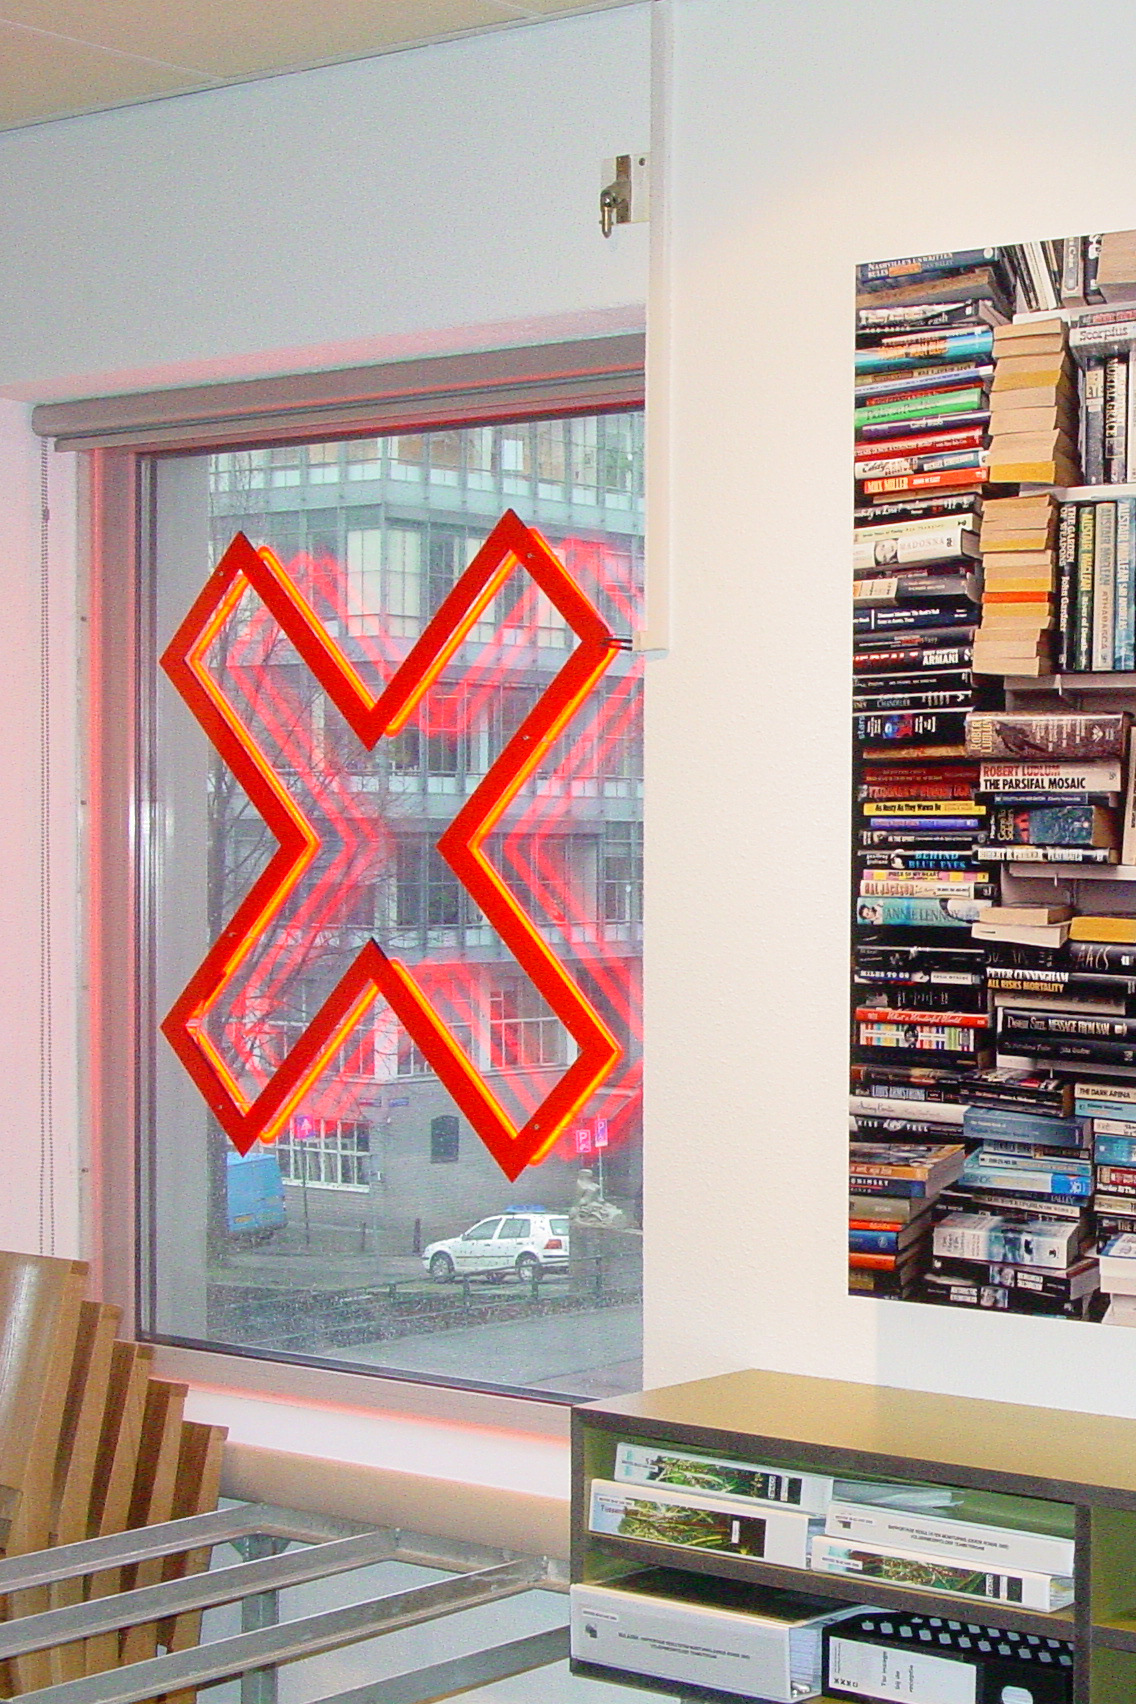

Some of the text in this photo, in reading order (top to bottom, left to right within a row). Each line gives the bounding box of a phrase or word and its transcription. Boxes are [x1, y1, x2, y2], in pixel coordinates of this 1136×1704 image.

[867, 252, 953, 271] NASHVILLE'S UNWRITTEN
[867, 268, 889, 279] RULES
[1079, 326, 1129, 342] Scorpius
[1105, 357, 1118, 437] MORTAL GRACE
[1100, 507, 1112, 546] ALISTAIR
[1118, 502, 1130, 541] ALISTAIR
[1066, 505, 1077, 562] THE GARDEN
[1081, 513, 1093, 551] ALISTAIR
[899, 538, 945, 550] MADONNA
[1059, 507, 1070, 632] OF WEAPONS John Gardner
[1081, 596, 1089, 616] River
[1100, 591, 1109, 650] ATHABASCA
[1118, 597, 1127, 630] ANDREAS
[1081, 617, 1089, 626] of
[1080, 627, 1089, 652] Death
[922, 653, 959, 666] ARMANI
[983, 765, 1061, 777] ROBERT LUDLUM
[983, 779, 1000, 790] THE
[1002, 778, 1046, 790] PARSIFAL
[1048, 777, 1086, 790] MOSAIC
[915, 852, 960, 860] BEHIND
[908, 860, 967, 869] BLUE EYES
[886, 908, 917, 921] ANNIE
[986, 967, 1013, 979] PETER
[987, 978, 1065, 993] ALL RISKS MORTALITY
[886, 1011, 905, 1020] What
[940, 1013, 962, 1024] World
[1048, 1019, 1077, 1033] MESSAGE
[1080, 1088, 1131, 1099] THE DARK ARENA
[579, 1132, 588, 1144] P
